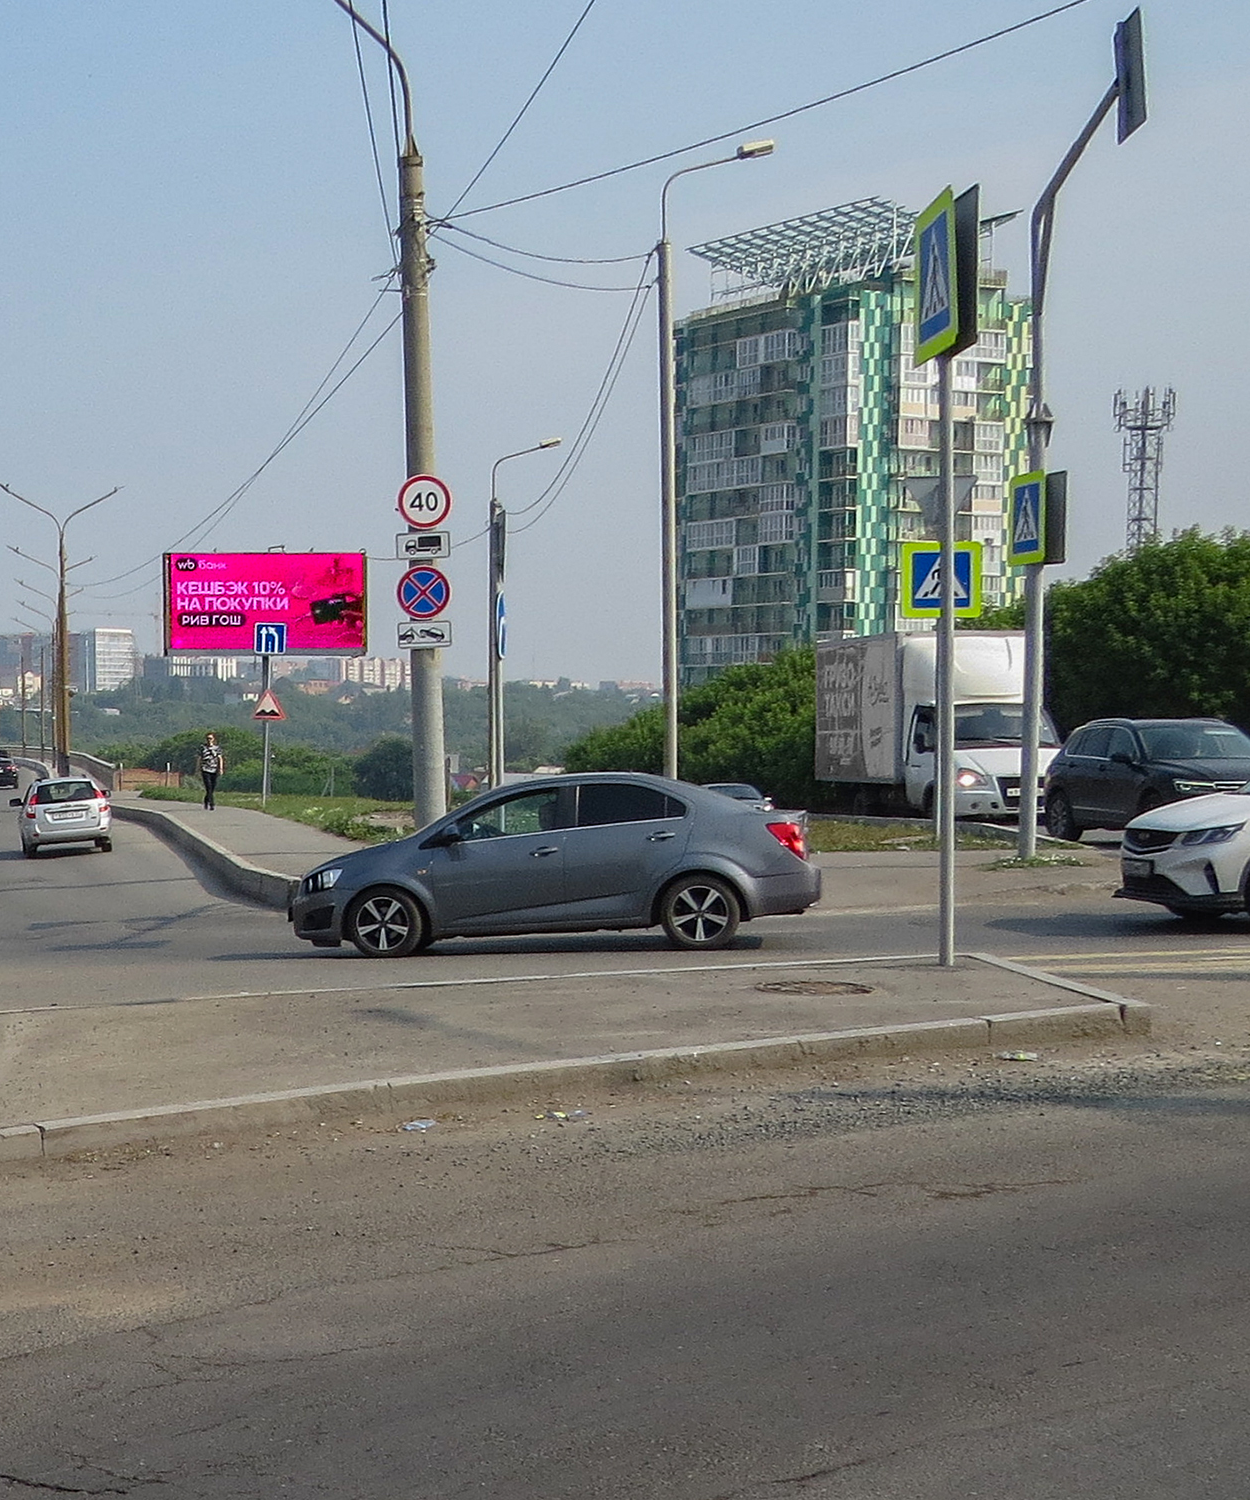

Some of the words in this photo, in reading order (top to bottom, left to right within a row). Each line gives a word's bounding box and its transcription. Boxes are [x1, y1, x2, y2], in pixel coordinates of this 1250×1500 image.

[409, 492, 438, 511] 40
[177, 559, 195, 570] wb
[198, 559, 227, 570] банк
[176, 582, 249, 595] КЕШБЭК
[252, 582, 286, 595] 10%
[176, 597, 201, 610] НА
[205, 597, 289, 610] ПОКУПКИ
[181, 615, 209, 626] РИВ
[212, 615, 241, 626] ГОШ
